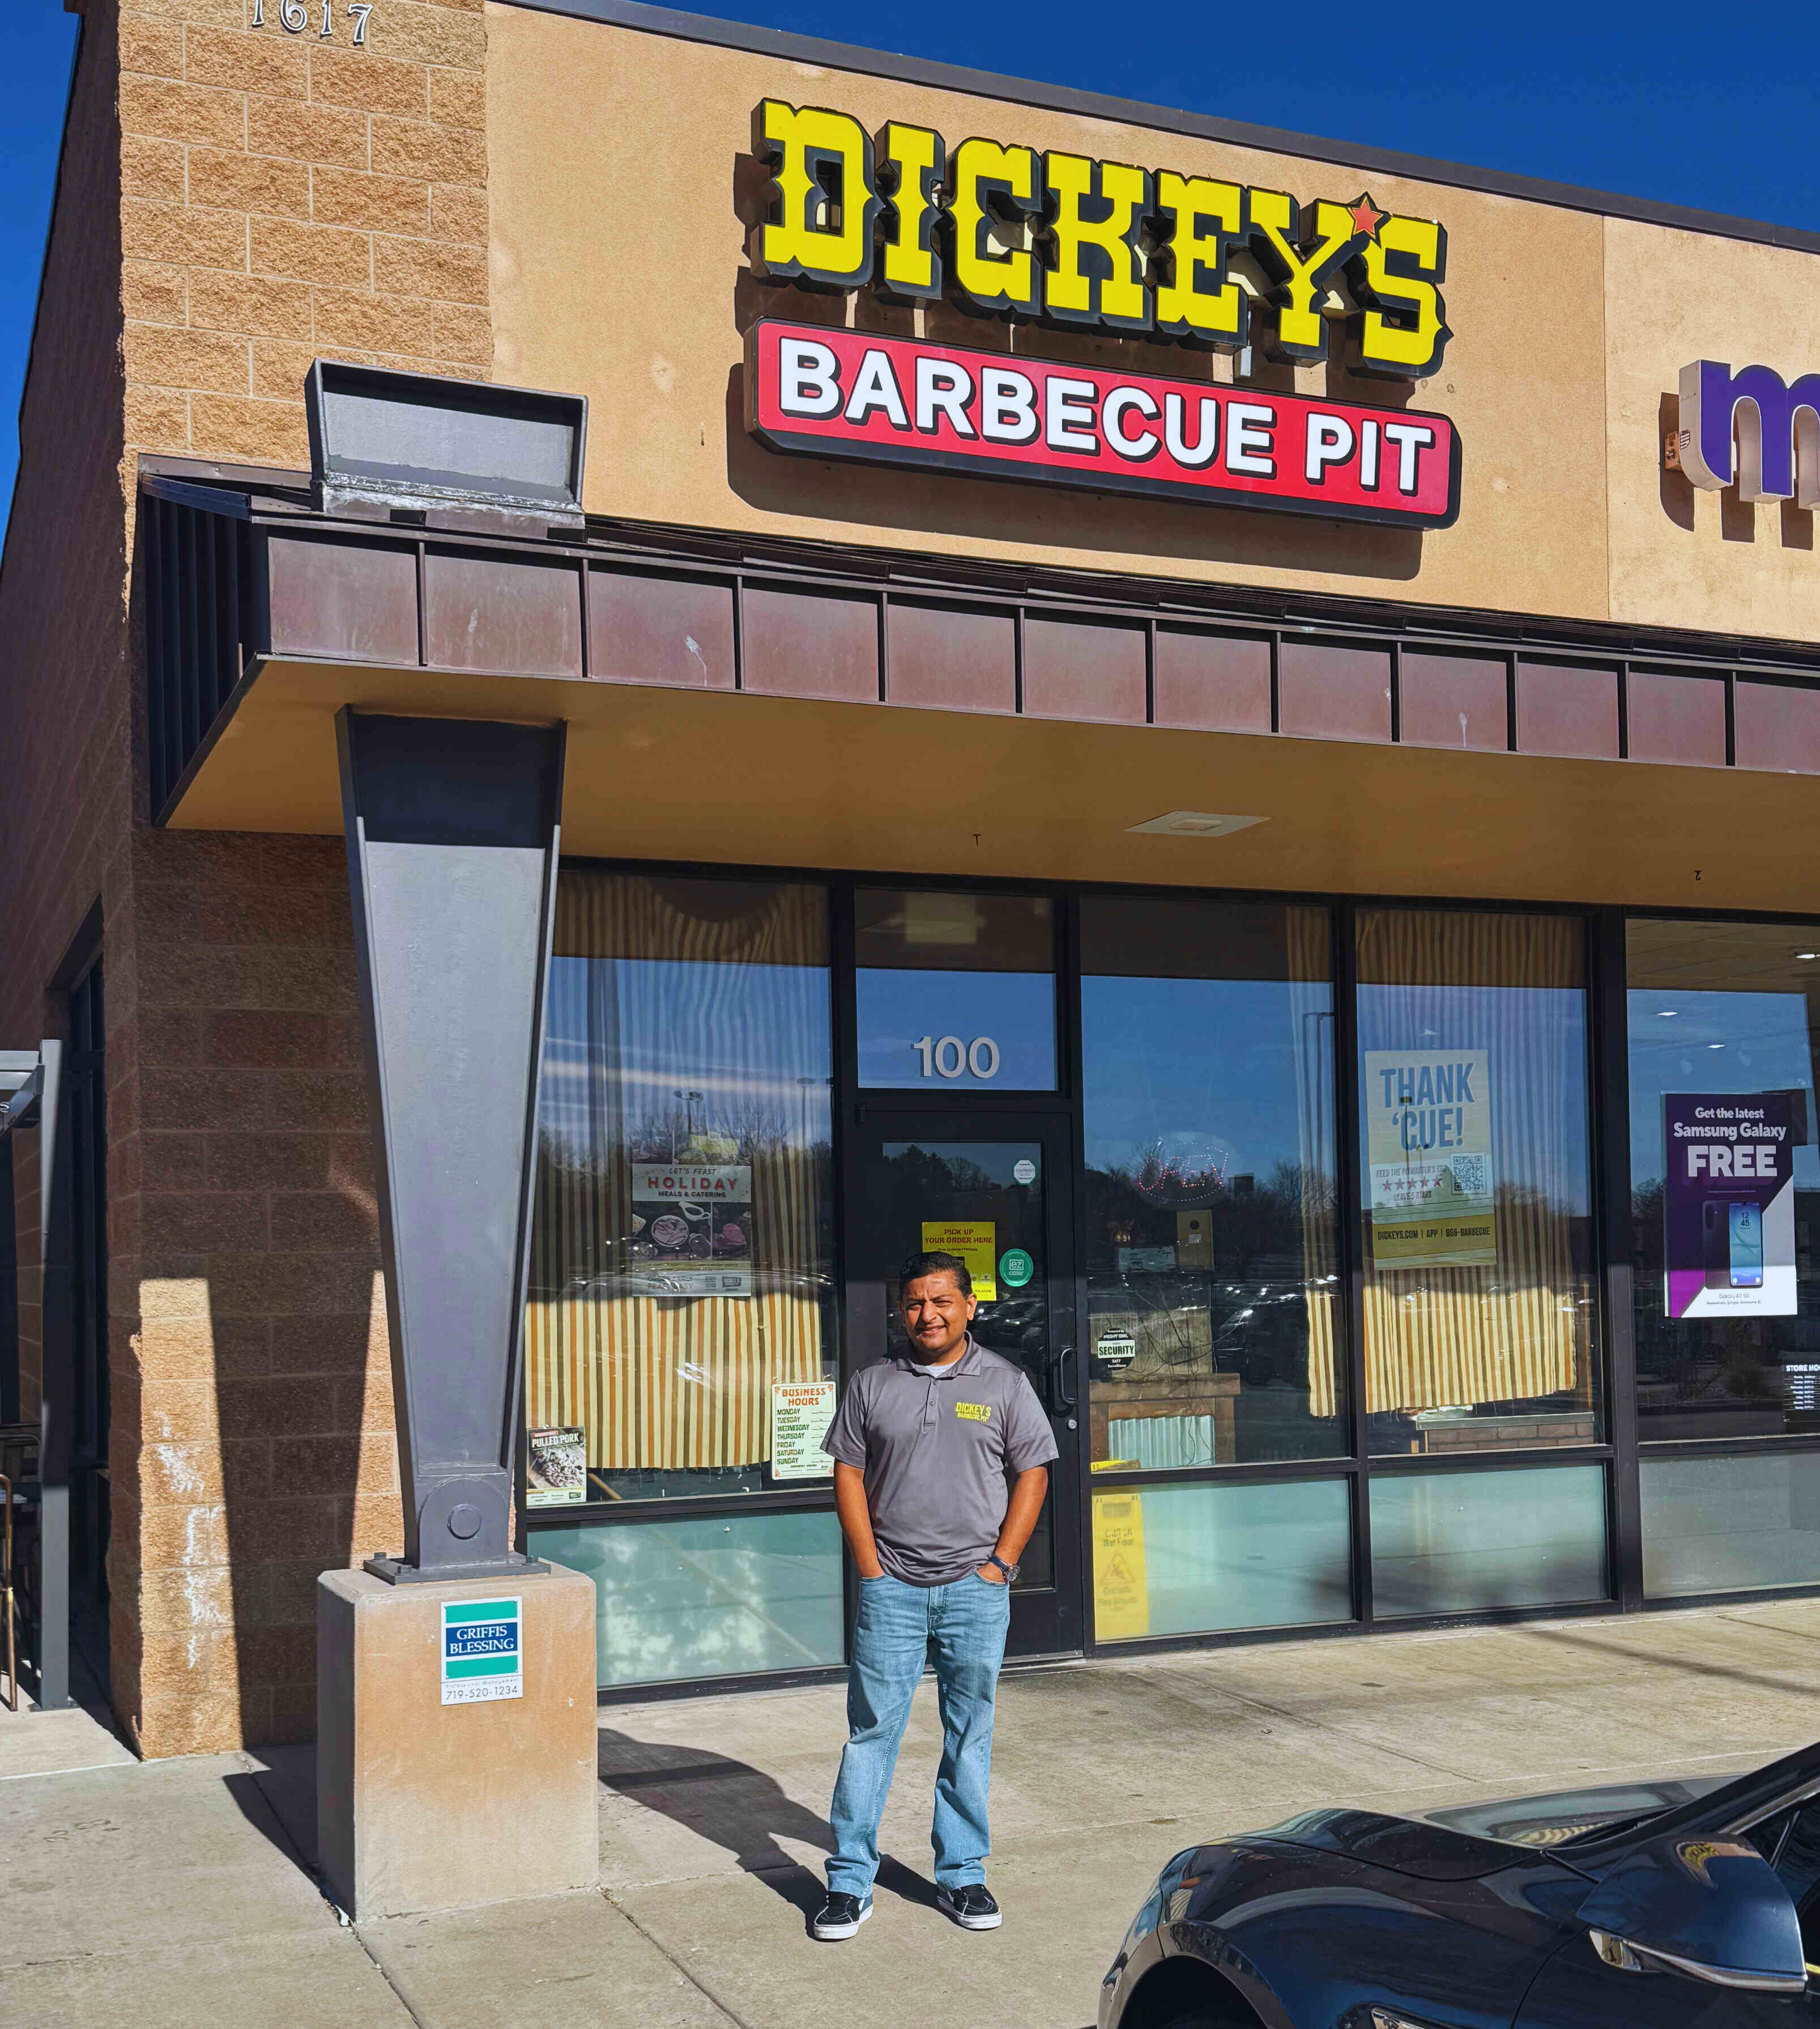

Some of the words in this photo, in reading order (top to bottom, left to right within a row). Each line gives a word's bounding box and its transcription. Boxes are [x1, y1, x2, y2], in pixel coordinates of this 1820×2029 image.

[252, 0, 373, 44] 1617
[779, 337, 1278, 480] BARBECUE
[1305, 412, 1435, 497] PIT
[911, 1036, 1000, 1079] 100
[1379, 1063, 1475, 1108] THANK
[1695, 1107, 1715, 1118] Get
[1716, 1108, 1734, 1118] the
[1735, 1108, 1764, 1118] latest
[1674, 1122, 1737, 1141] Samsung
[1740, 1122, 1787, 1141] Galaxy
[1687, 1145, 1778, 1177] FREE
[647, 1176, 737, 1190] HOLIDAY
[1378, 1230, 1418, 1240] DICKEYS.COM
[1426, 1229, 1438, 1238] APP
[1446, 1227, 1491, 1237] 866-BARBECUE
[1099, 1345, 1133, 1356] SECURITY
[788, 1397, 820, 1407] HOURS
[531, 1435, 558, 1448] PULLED
[560, 1432, 579, 1443] PORK
[457, 1625, 508, 1640] GRIFFIS
[450, 1638, 514, 1654] BLESSING
[446, 1686, 518, 1700] 719-520-1234
